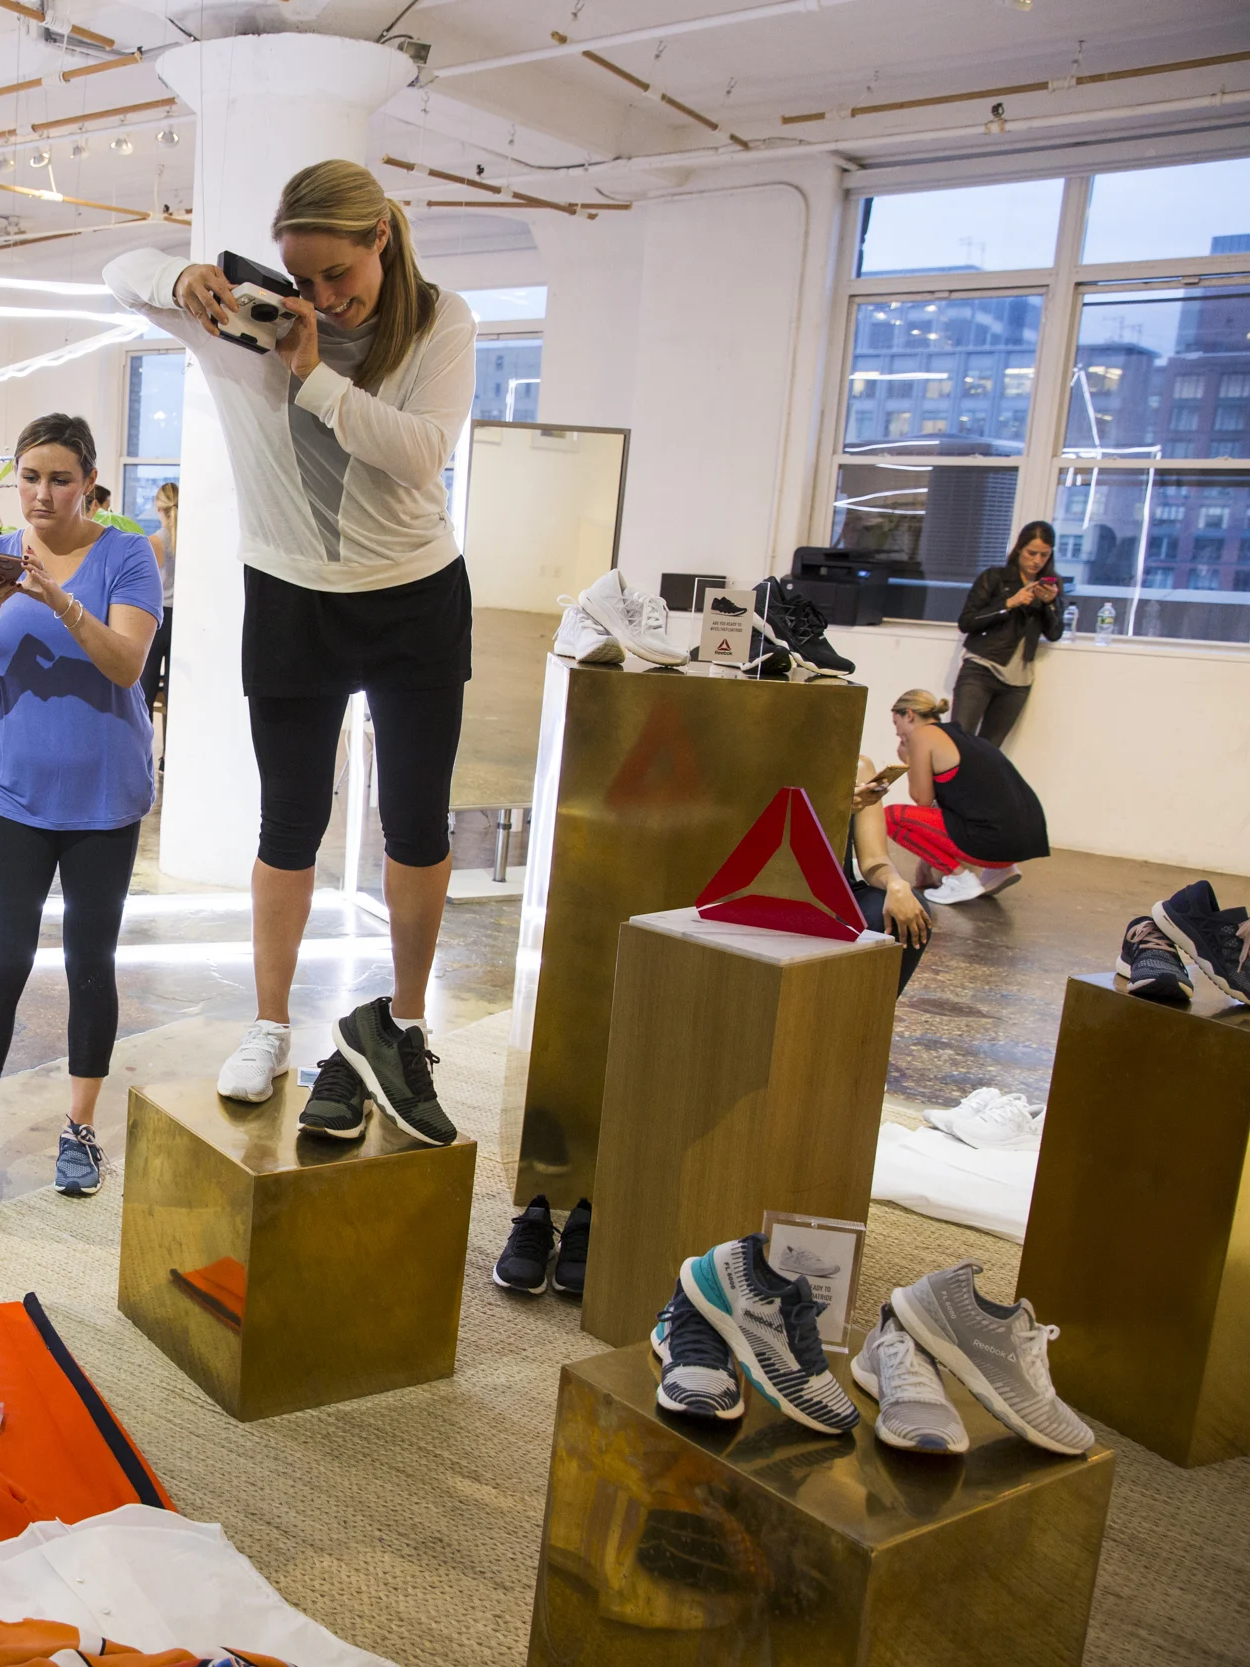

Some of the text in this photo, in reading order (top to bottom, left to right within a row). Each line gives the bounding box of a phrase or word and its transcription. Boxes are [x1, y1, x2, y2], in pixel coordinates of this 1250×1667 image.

[810, 1283, 832, 1293] EADY TO
[744, 1309, 774, 1328] Reebok
[973, 1338, 1006, 1359] Reebok
